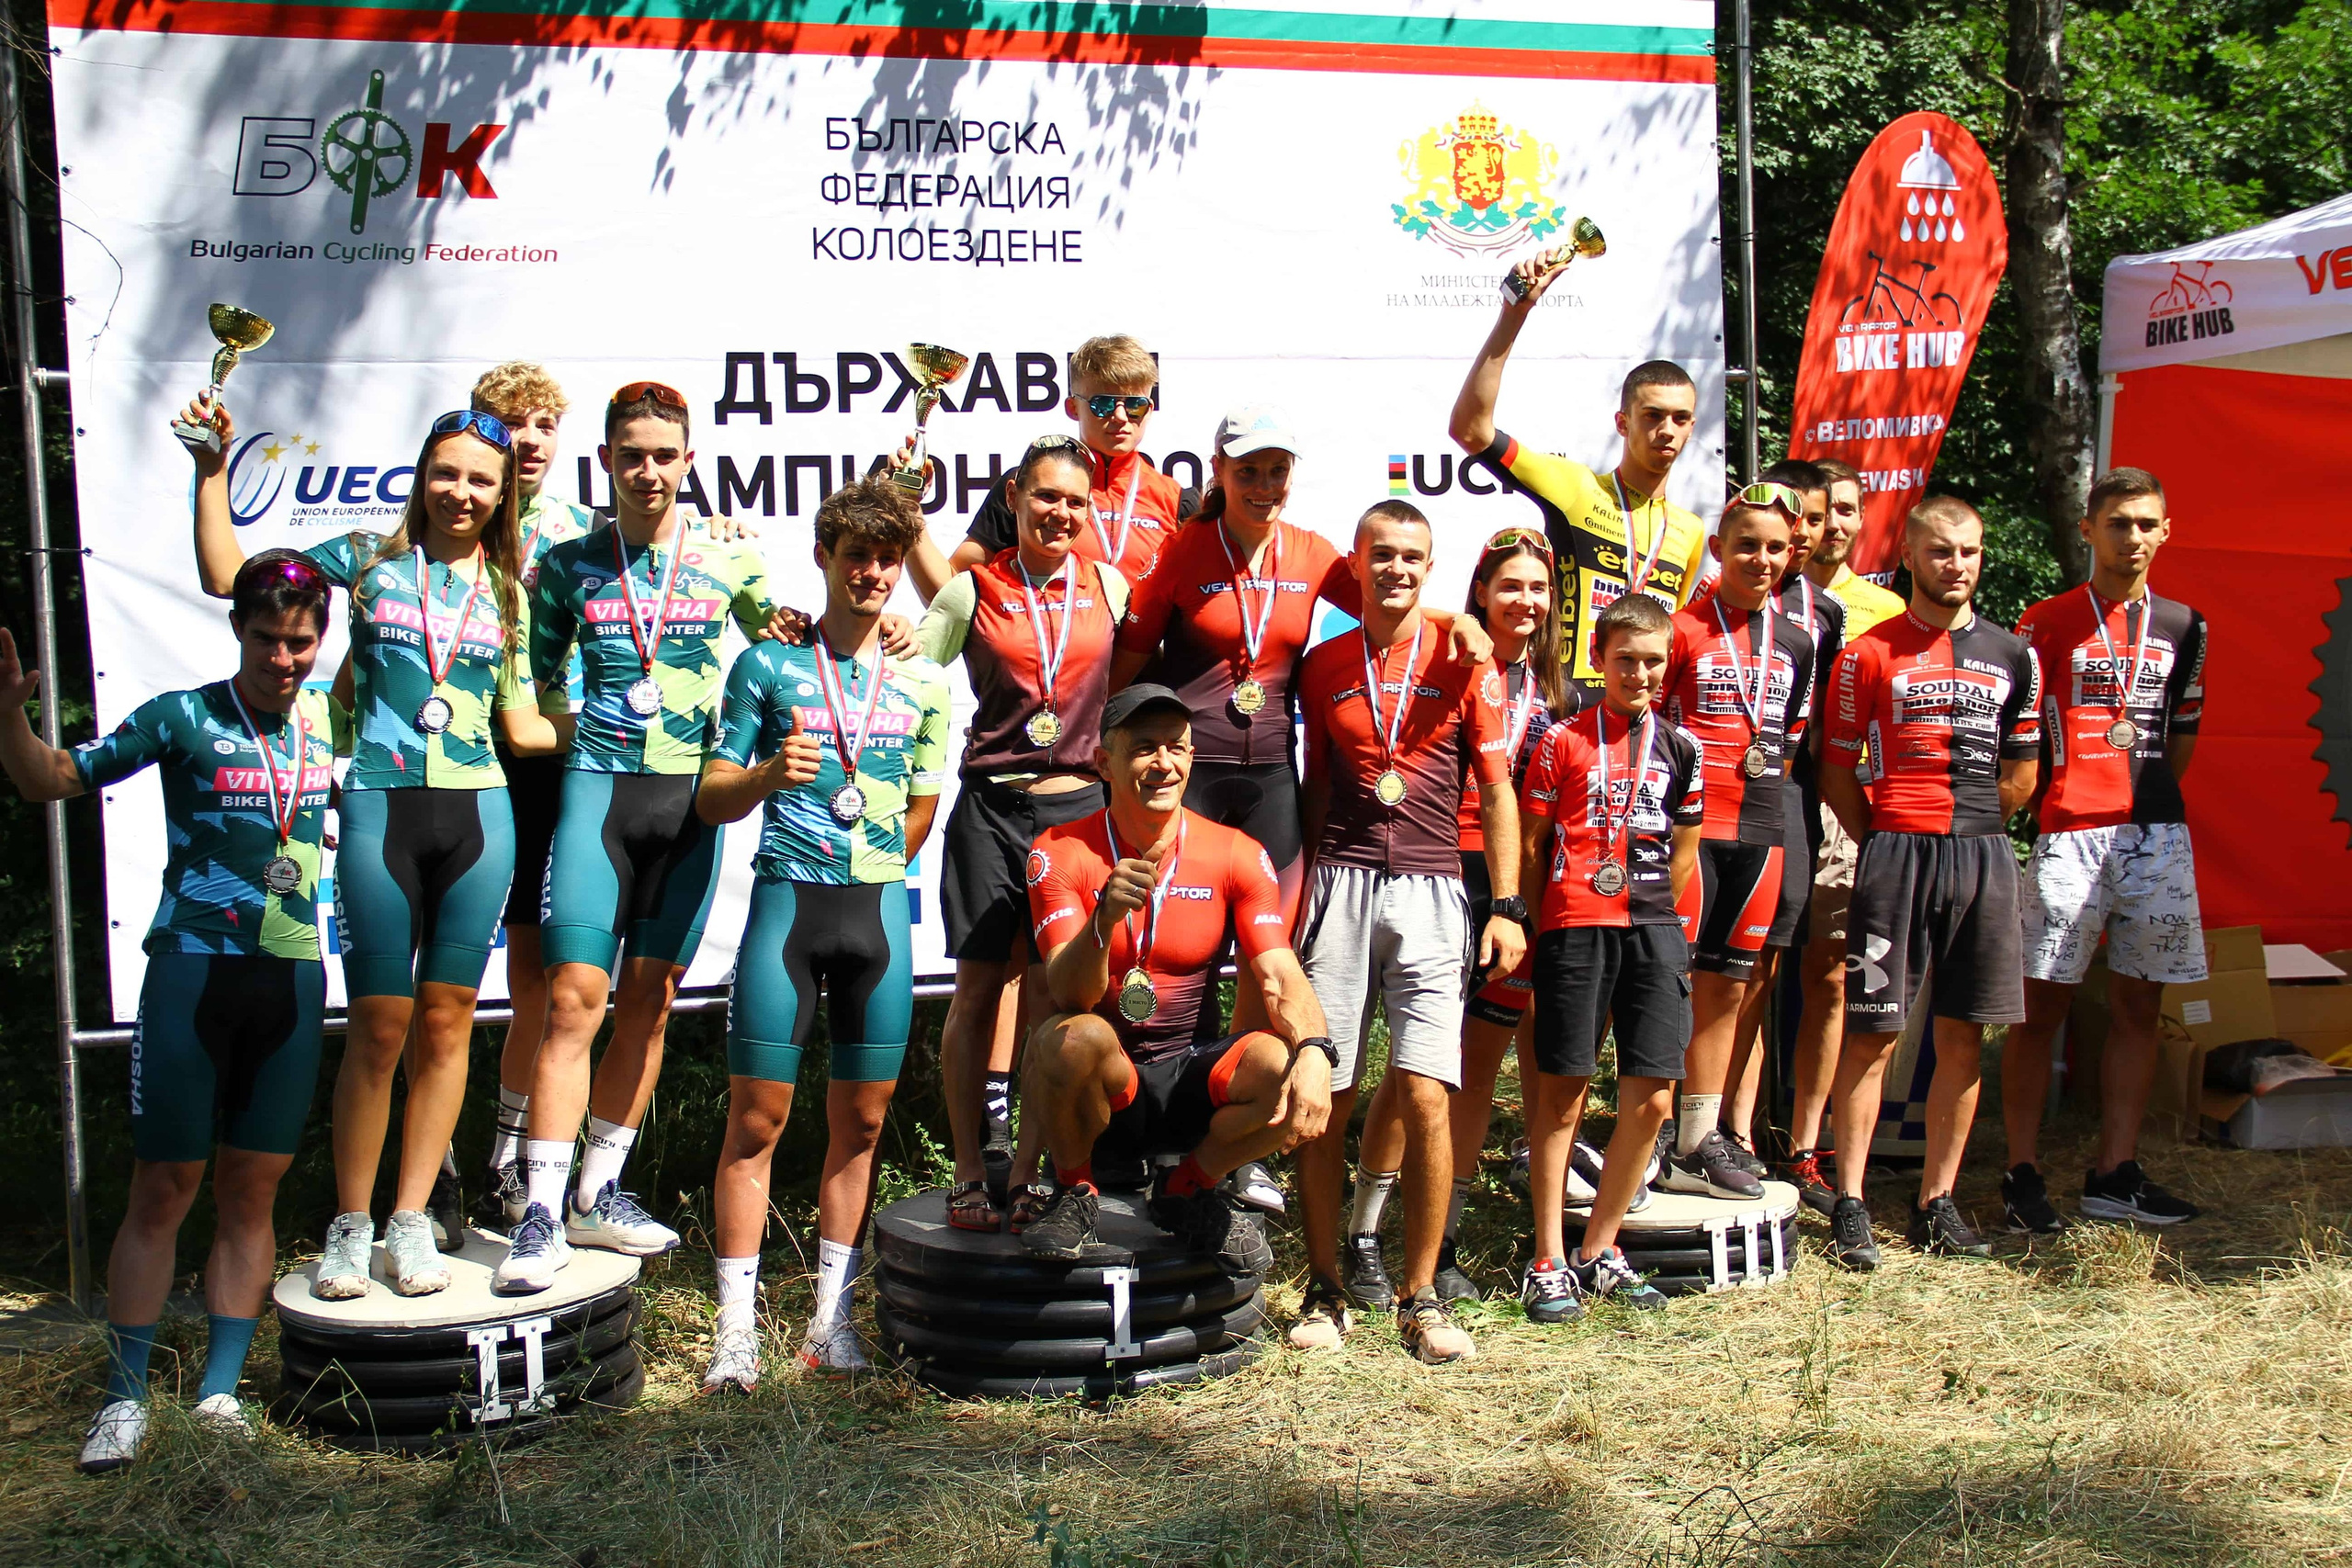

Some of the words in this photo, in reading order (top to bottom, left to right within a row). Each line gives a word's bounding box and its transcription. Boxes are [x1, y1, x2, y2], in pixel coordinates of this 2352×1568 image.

[825, 117, 1067, 155] БЪЛГАРСКА
[820, 172, 1069, 214] ФЕДЕРАЦИЯ
[189, 239, 314, 263] Bulgarian
[322, 241, 416, 265] Cycling
[424, 243, 559, 264] Federation
[812, 227, 1083, 267] КОЛОЕЗДЕНЕ
[1420, 275, 1507, 288] МИНИСТЕР
[1385, 294, 1409, 308] НА
[2145, 314, 2188, 348] BIKE
[2192, 307, 2235, 340] HUB
[1835, 333, 1901, 373] BIKE
[1906, 331, 1966, 369] HUB
[1817, 413, 1947, 443] ВЕЛОМИВКА
[295, 466, 417, 504] UEC
[1412, 454, 1514, 496] UC
[289, 517, 305, 526] DE
[307, 517, 364, 526] CYCLISME
[291, 507, 328, 516] UNION
[1592, 503, 1624, 525] KALIN
[1584, 516, 1627, 539] Continent
[379, 626, 422, 647] BIKE
[595, 625, 632, 636] BIKE
[1962, 658, 2010, 680] KALINEL
[1838, 651, 1860, 723] KALINEL
[1905, 681, 1996, 703] SOUDAL
[2021, 657, 2041, 713] SOUDAL
[1902, 697, 1949, 709] bike
[1953, 697, 1996, 713] shop
[2047, 706, 2062, 755] SOUDAL
[1539, 715, 1580, 772] KALINEL
[1683, 730, 1703, 780] SOUDAL
[1873, 729, 1882, 773] SOUDAL
[221, 795, 267, 807] BIKE
[1253, 913, 1284, 926] MAX
[2042, 916, 2080, 930] NOW
[2148, 913, 2187, 925] NOW
[1849, 1003, 1899, 1013] ARMOUR
